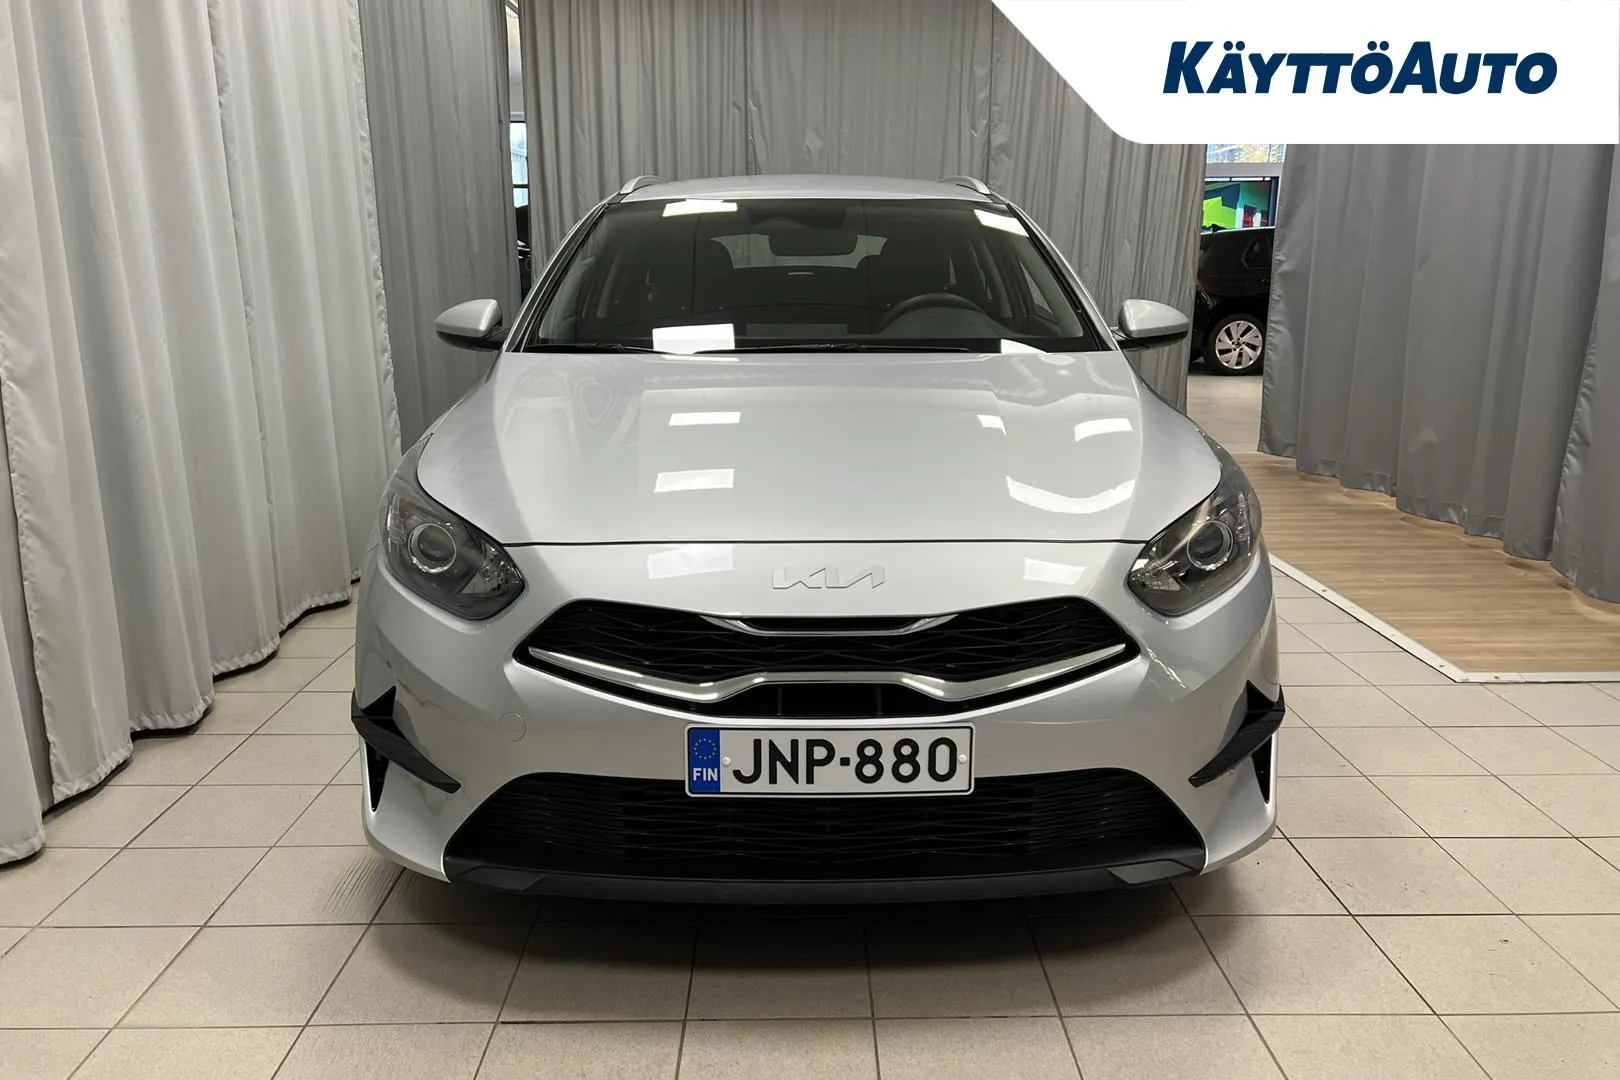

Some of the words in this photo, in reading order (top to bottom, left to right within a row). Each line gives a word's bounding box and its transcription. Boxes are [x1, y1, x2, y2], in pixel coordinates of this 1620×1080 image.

[772, 566, 885, 589] KIA
[692, 767, 719, 782] FIN
[732, 737, 958, 785] JNP-880
